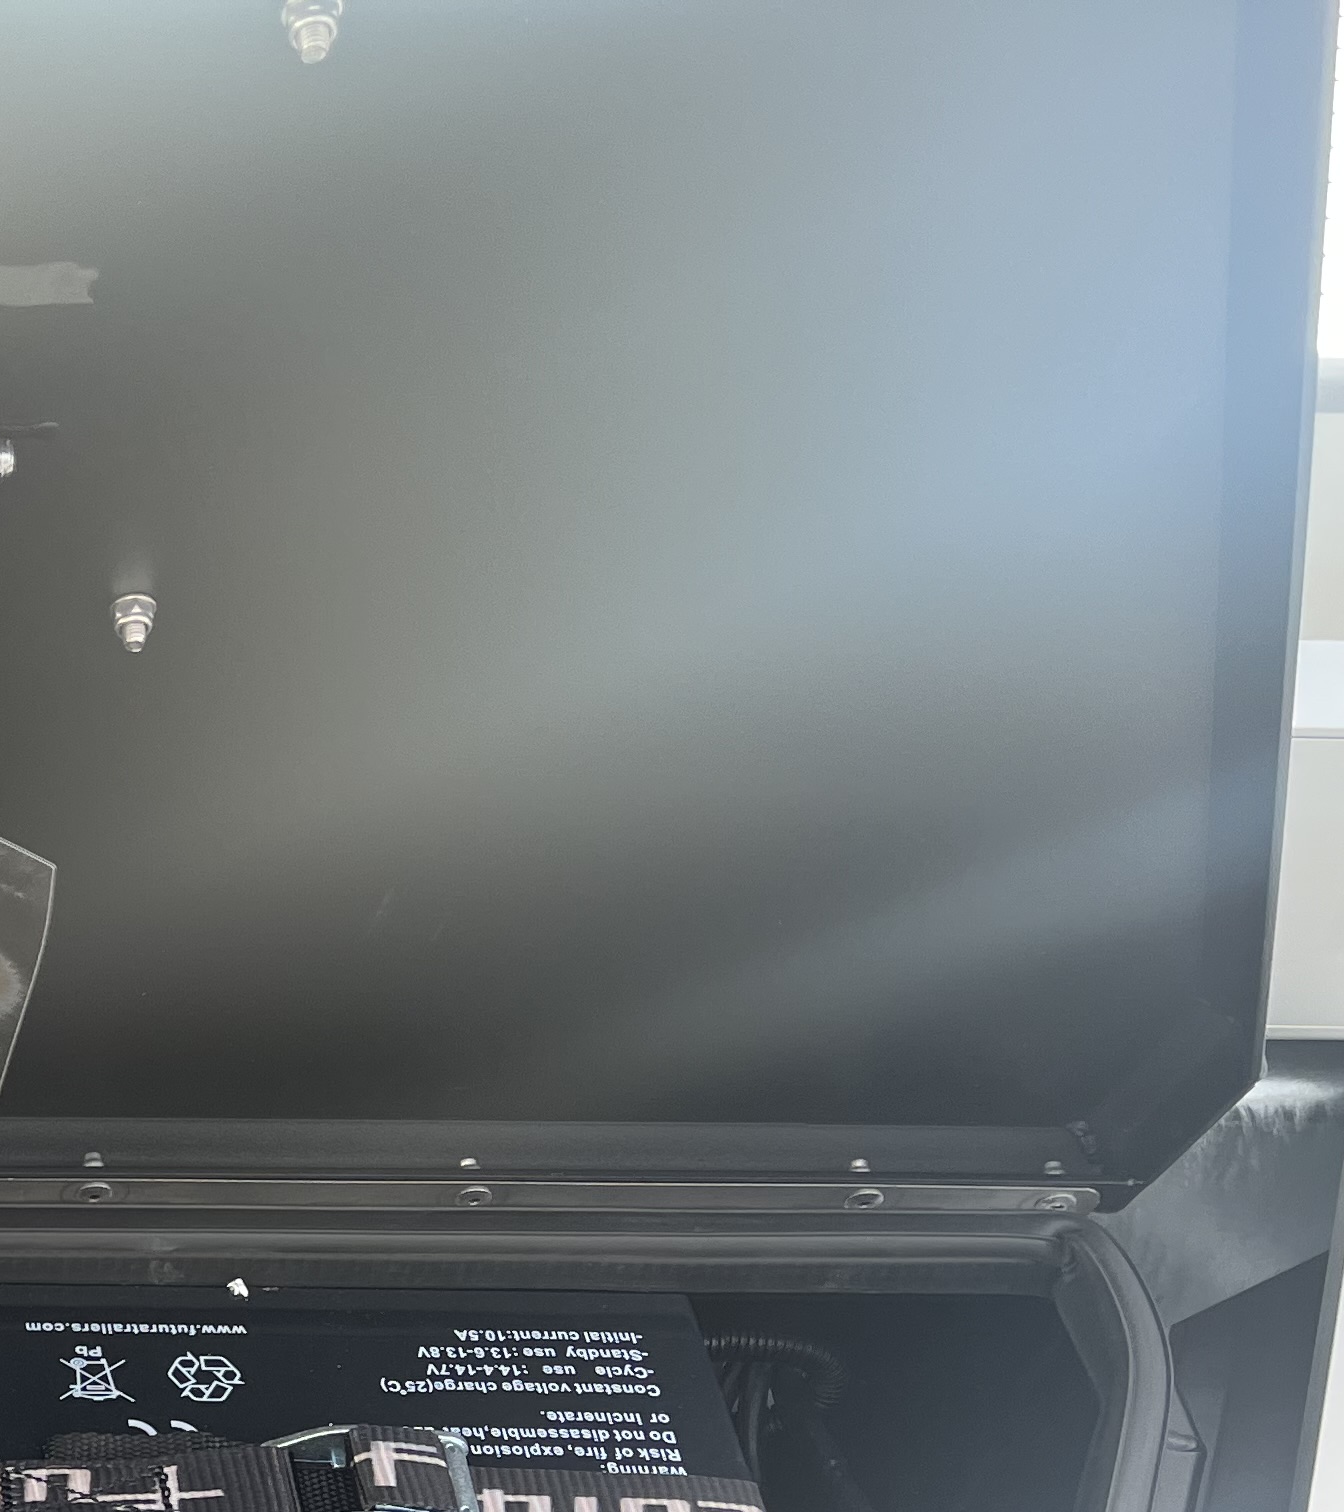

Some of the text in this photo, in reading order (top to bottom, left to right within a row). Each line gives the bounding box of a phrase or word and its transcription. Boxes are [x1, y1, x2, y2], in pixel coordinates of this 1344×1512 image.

[24, 1321, 248, 1336] www.futuratrailers.com
[74, 1345, 103, 1358] Pb
[522, 1347, 557, 1358] use
[566, 1347, 649, 1361] -Standby
[541, 1363, 577, 1375] use
[595, 1364, 655, 1379] -Cycle
[502, 1380, 572, 1395] voltage
[574, 1383, 662, 1397] Constant
[539, 1411, 671, 1425] or incinerate.
[612, 1428, 646, 1443] not
[657, 1430, 678, 1444] Do
[470, 1443, 564, 1459] explosion
[611, 1446, 634, 1460] of
[636, 1447, 682, 1462] Risk
